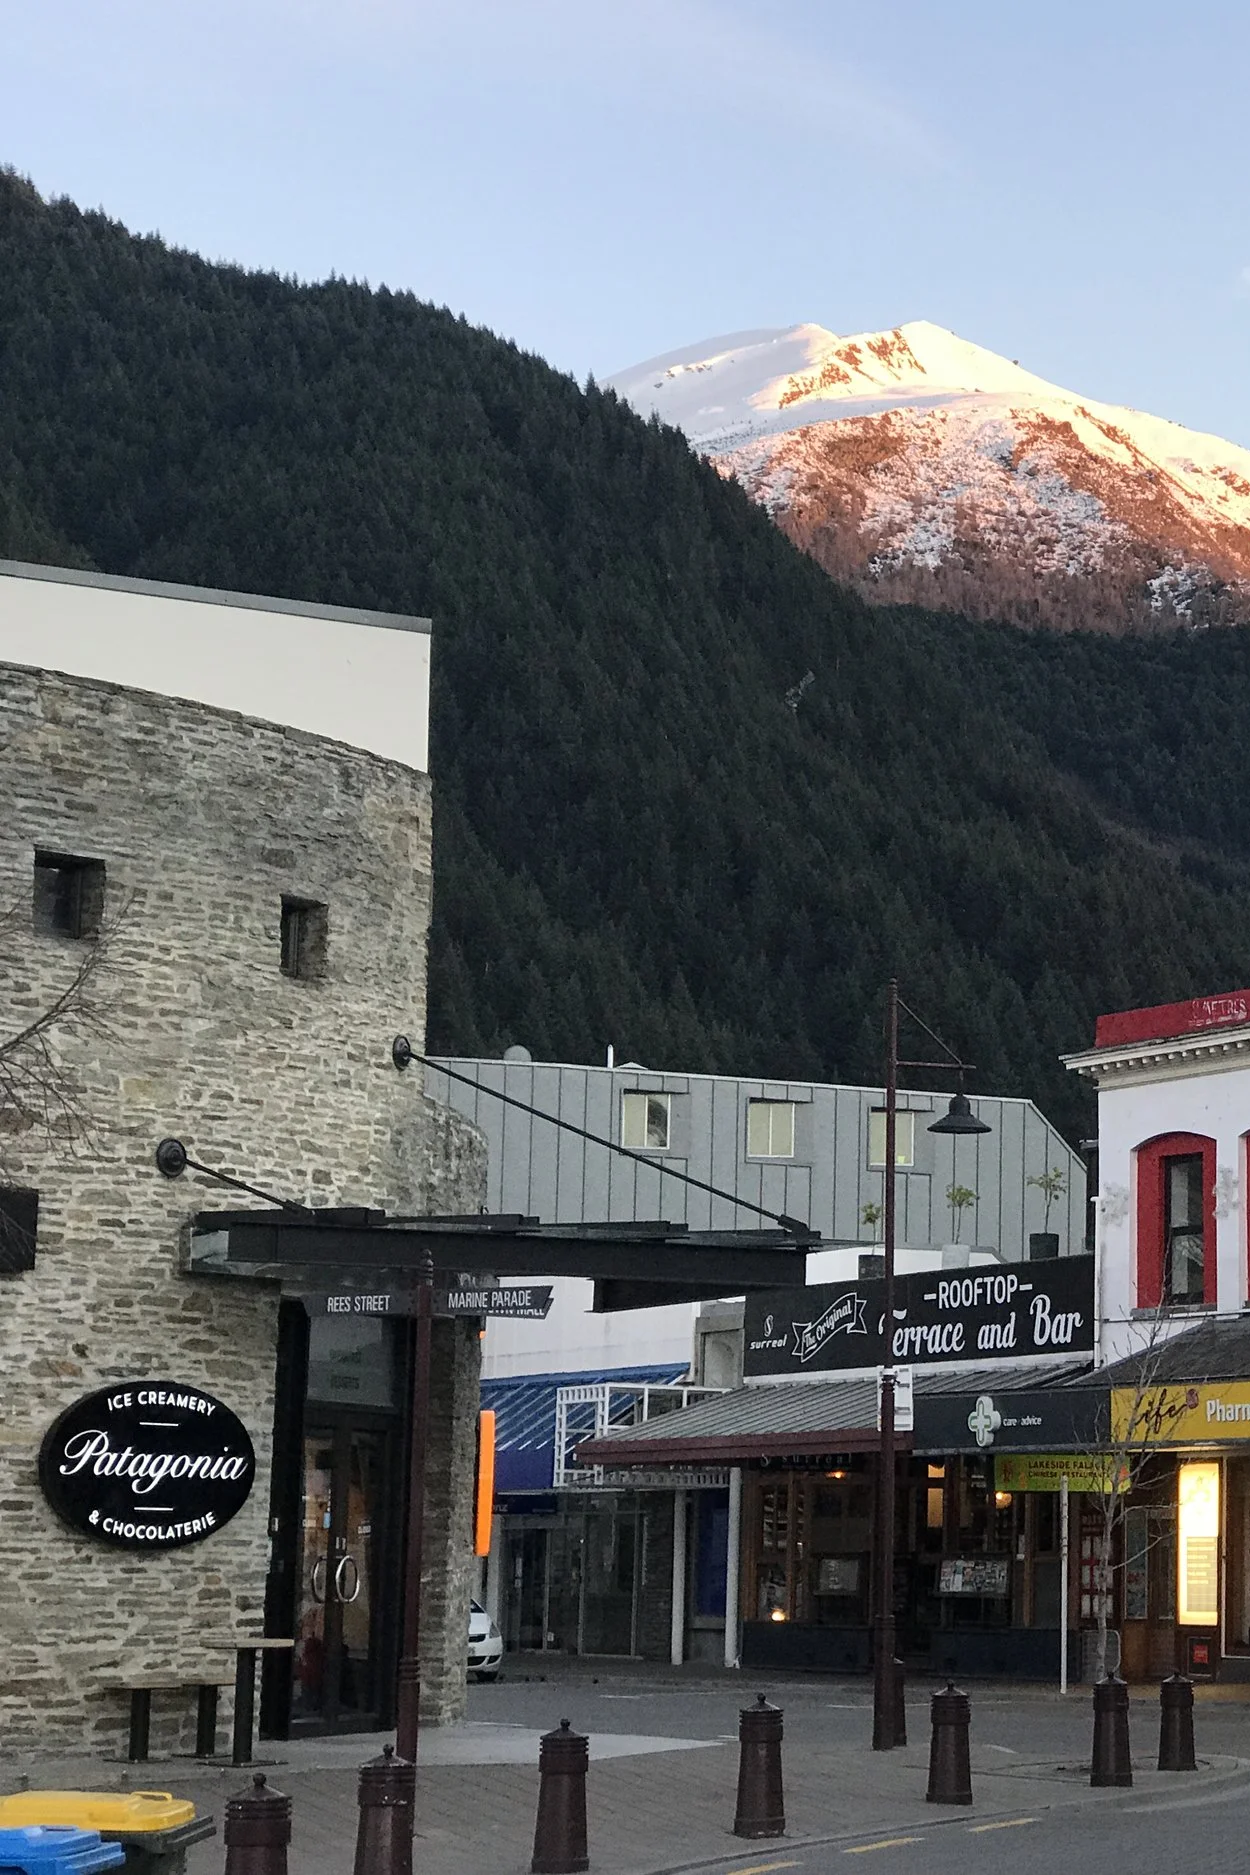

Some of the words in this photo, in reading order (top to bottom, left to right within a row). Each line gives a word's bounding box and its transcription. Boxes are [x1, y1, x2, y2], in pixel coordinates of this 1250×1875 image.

[327, 1296, 350, 1313] REES
[354, 1294, 390, 1313] STREET
[448, 1293, 488, 1309] MARINE
[491, 1290, 532, 1308] PARADE
[815, 1299, 853, 1341] Original
[977, 1311, 1017, 1350] and
[1029, 1293, 1084, 1346] Bar
[107, 1393, 132, 1411] ICE
[137, 1391, 216, 1416] CREAMERY
[1002, 1418, 1018, 1427] care
[1020, 1415, 1042, 1426] advice
[59, 1429, 248, 1494] Patagonia
[1028, 1460, 1071, 1470] LAKESIDE
[88, 1509, 100, 1525] &
[102, 1511, 217, 1540] CHOCOLATERIE
